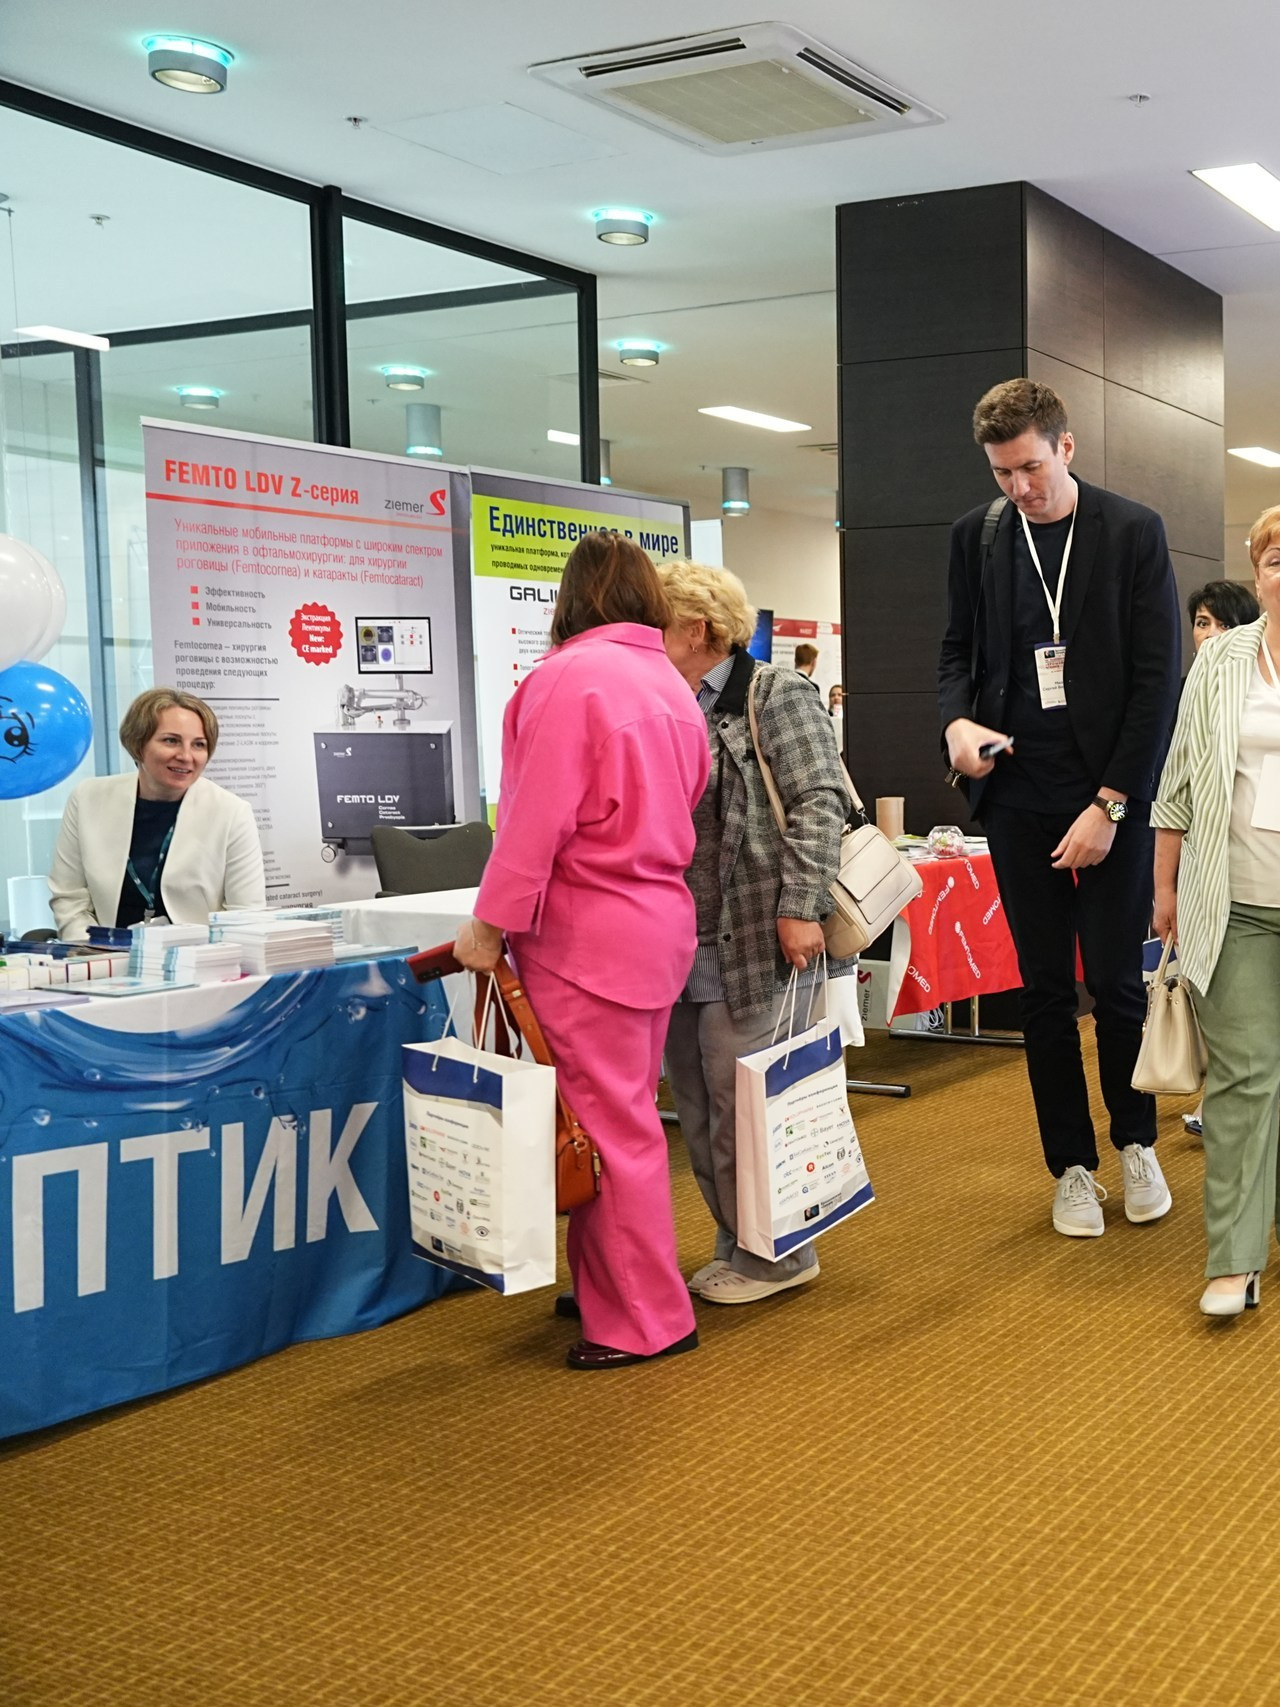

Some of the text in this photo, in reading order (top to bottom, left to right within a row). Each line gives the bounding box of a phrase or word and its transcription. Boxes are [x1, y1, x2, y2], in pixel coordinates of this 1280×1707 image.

[165, 459, 359, 507] FEMTO LDV Z-серия
[384, 499, 425, 513] ziemer
[174, 518, 238, 538] Уникальные
[241, 526, 297, 544] мобильные
[300, 534, 353, 549] платформы
[363, 540, 404, 554] широким
[405, 544, 443, 559] спектром
[489, 506, 679, 558] Единствен мире
[176, 539, 407, 570] приложения в офтальмохирургии: для хирургии
[491, 544, 525, 554] уникальная
[491, 560, 528, 570] проводимых
[177, 558, 424, 588] роговицы (Femtocornea) и катаракты (Femtocataract)
[205, 586, 266, 600] Эффективность
[206, 601, 257, 614] Мобильность
[207, 617, 272, 630] Универсальность
[174, 640, 223, 651] Femtocornea
[231, 643, 267, 653] хирургия
[175, 654, 214, 665] роговицы
[221, 656, 279, 665] возможностью
[176, 668, 268, 678] проведения следующих
[176, 680, 216, 690] процедур:
[336, 795, 400, 803] FEMTO LDV
[958, 929, 981, 979] FEMTOMED
